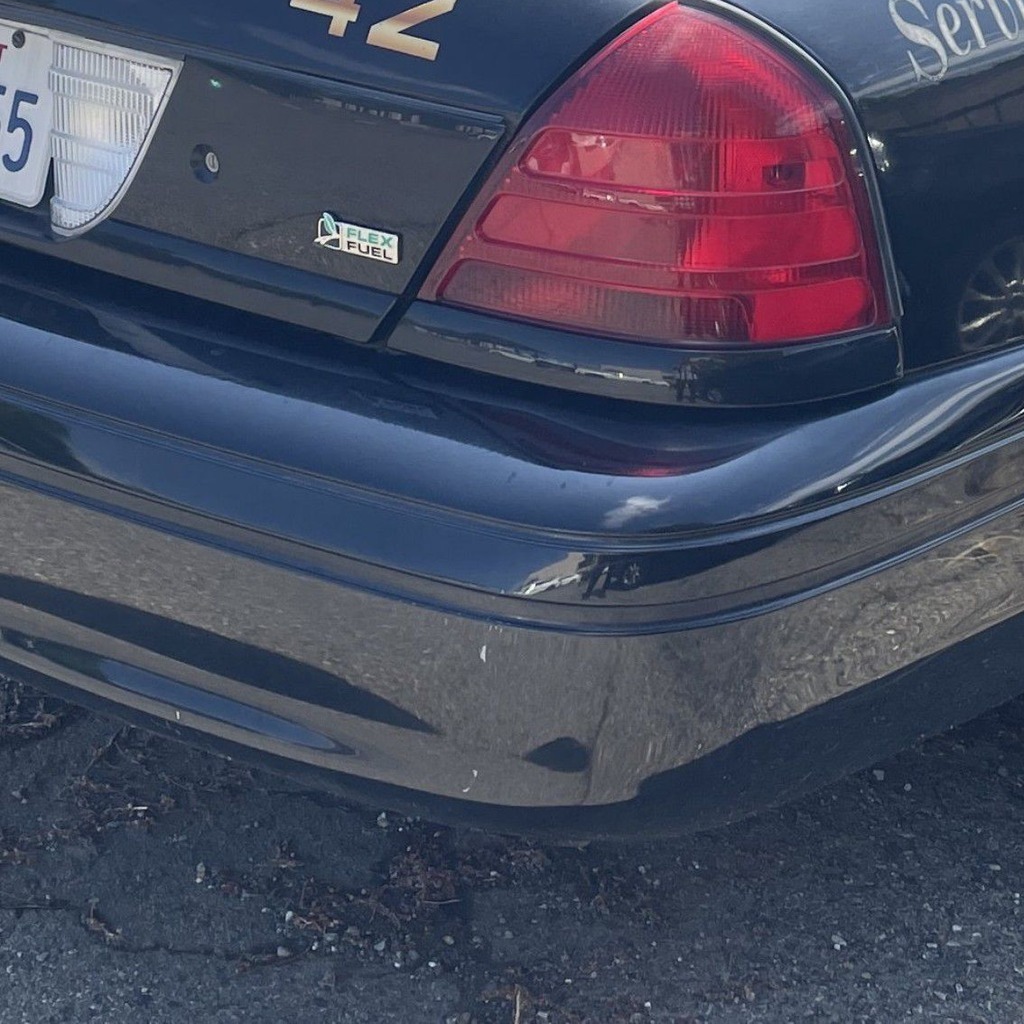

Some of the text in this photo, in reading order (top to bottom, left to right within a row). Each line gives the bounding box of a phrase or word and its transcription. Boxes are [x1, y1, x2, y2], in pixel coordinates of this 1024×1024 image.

[0, 86, 39, 173] 5
[347, 227, 393, 248] FLEX
[347, 241, 393, 261] FUEL
